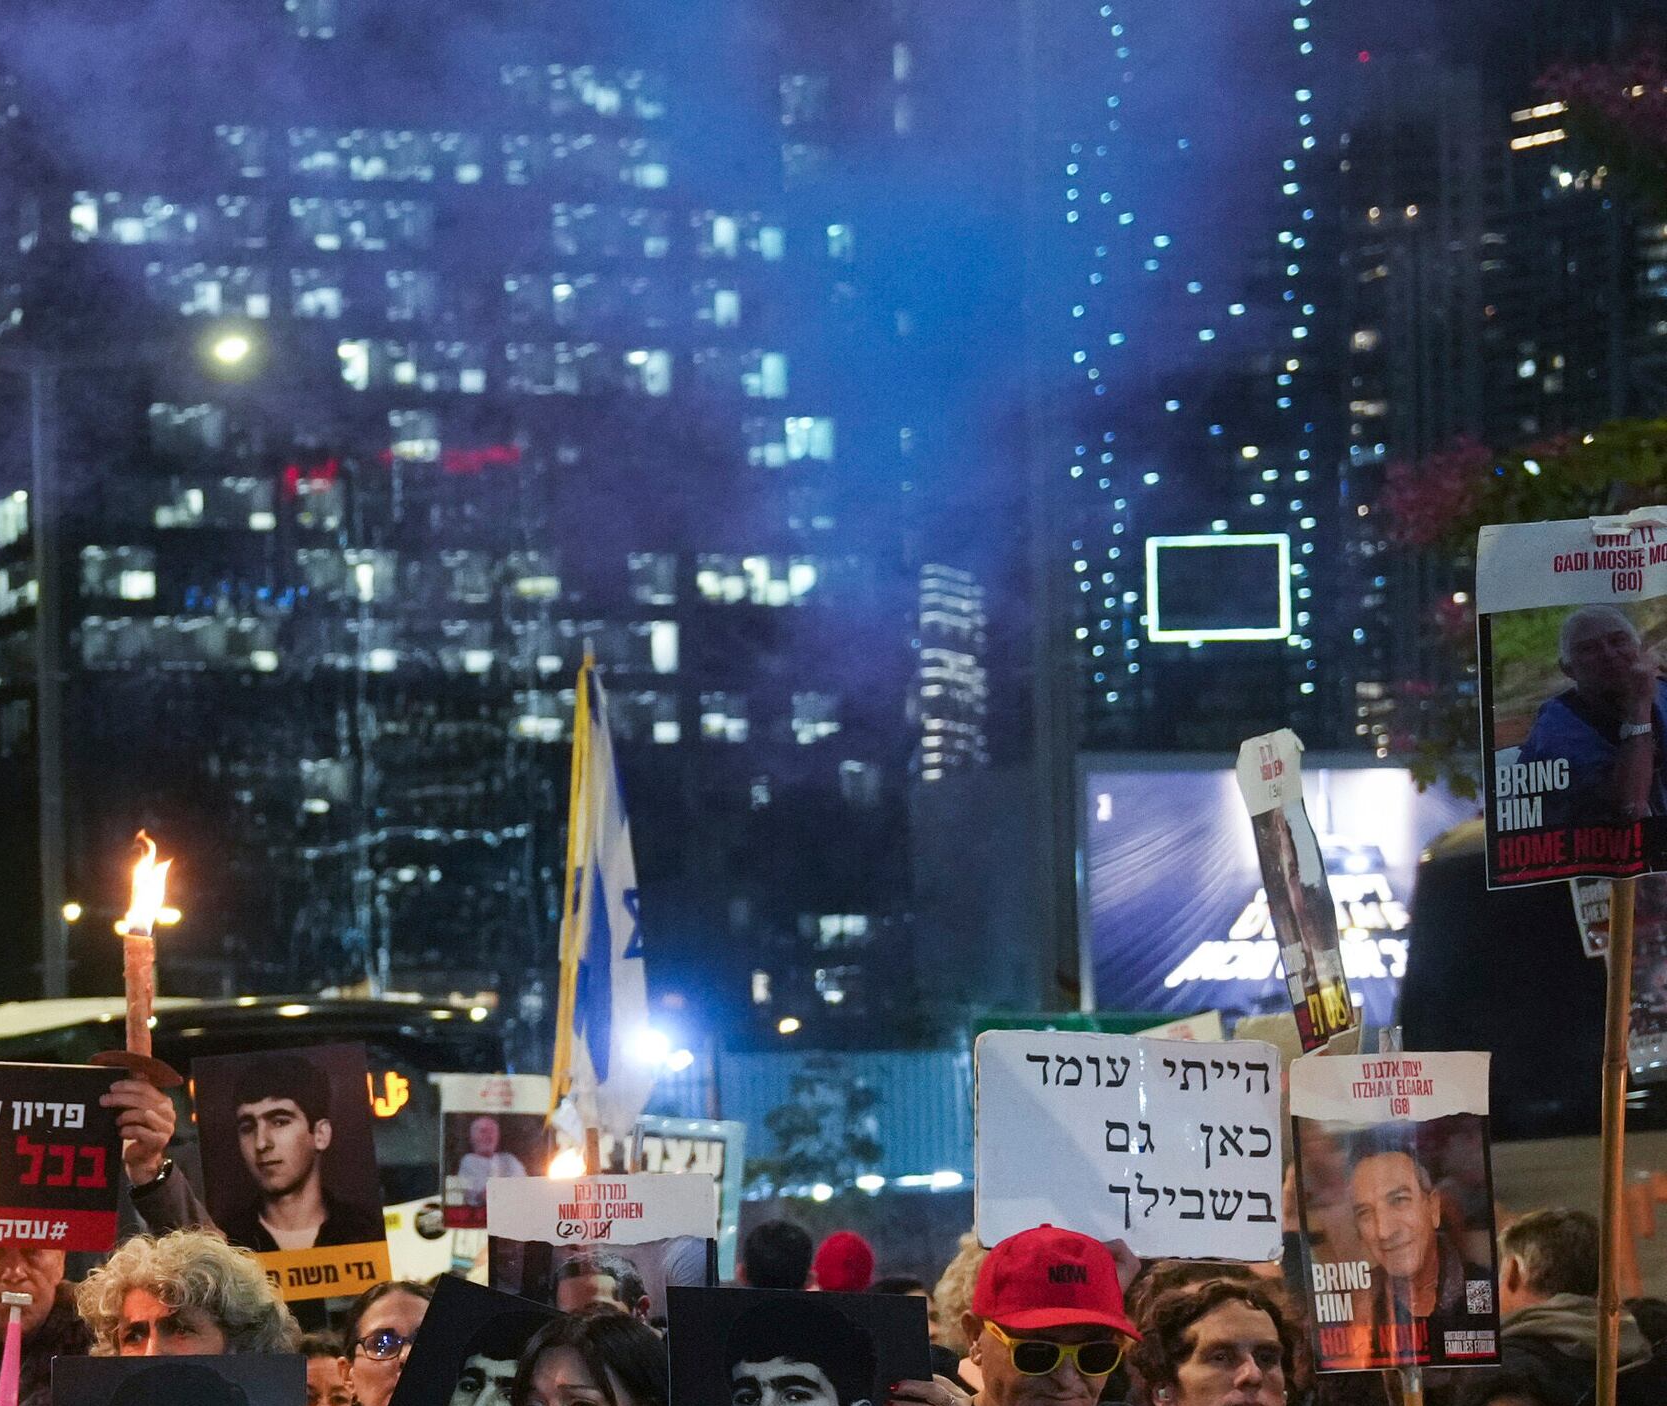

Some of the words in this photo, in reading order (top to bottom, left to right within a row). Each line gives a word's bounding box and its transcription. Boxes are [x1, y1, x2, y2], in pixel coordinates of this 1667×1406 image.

[1553, 552, 1589, 573] GADI
[1593, 549, 1646, 571] MOSHE
[1611, 570, 1643, 594] (80)
[1495, 758, 1569, 798] BRING
[1496, 797, 1543, 832] HIM
[1497, 829, 1565, 869] HOME
[1574, 821, 1643, 862] NOW!
[1026, 1053, 1131, 1087] עומד
[1163, 1056, 1270, 1094] הייתי
[1352, 1080, 1393, 1098] ITZHAK
[1396, 1079, 1433, 1097] ELGARAT
[11, 1101, 86, 1130] פדיון
[1390, 1098, 1410, 1116] (68)
[1105, 1120, 1155, 1153] גם
[1200, 1122, 1271, 1169] כאן
[16, 1135, 108, 1188] בכל
[574, 1184, 592, 1205] כהן
[597, 1184, 627, 1200] נמרוד
[1108, 1171, 1277, 1230] בשבילך
[558, 1203, 601, 1220] NIMROD
[605, 1203, 643, 1219] COHEN
[556, 1220, 588, 1240] (20)
[287, 1265, 340, 1287] משה
[344, 1260, 376, 1281] גדי
[1311, 1261, 1372, 1293] BRING
[1315, 1293, 1354, 1323] HIM
[1444, 1341, 1474, 1354] FAMILIES
[1475, 1341, 1496, 1354] FORUM
